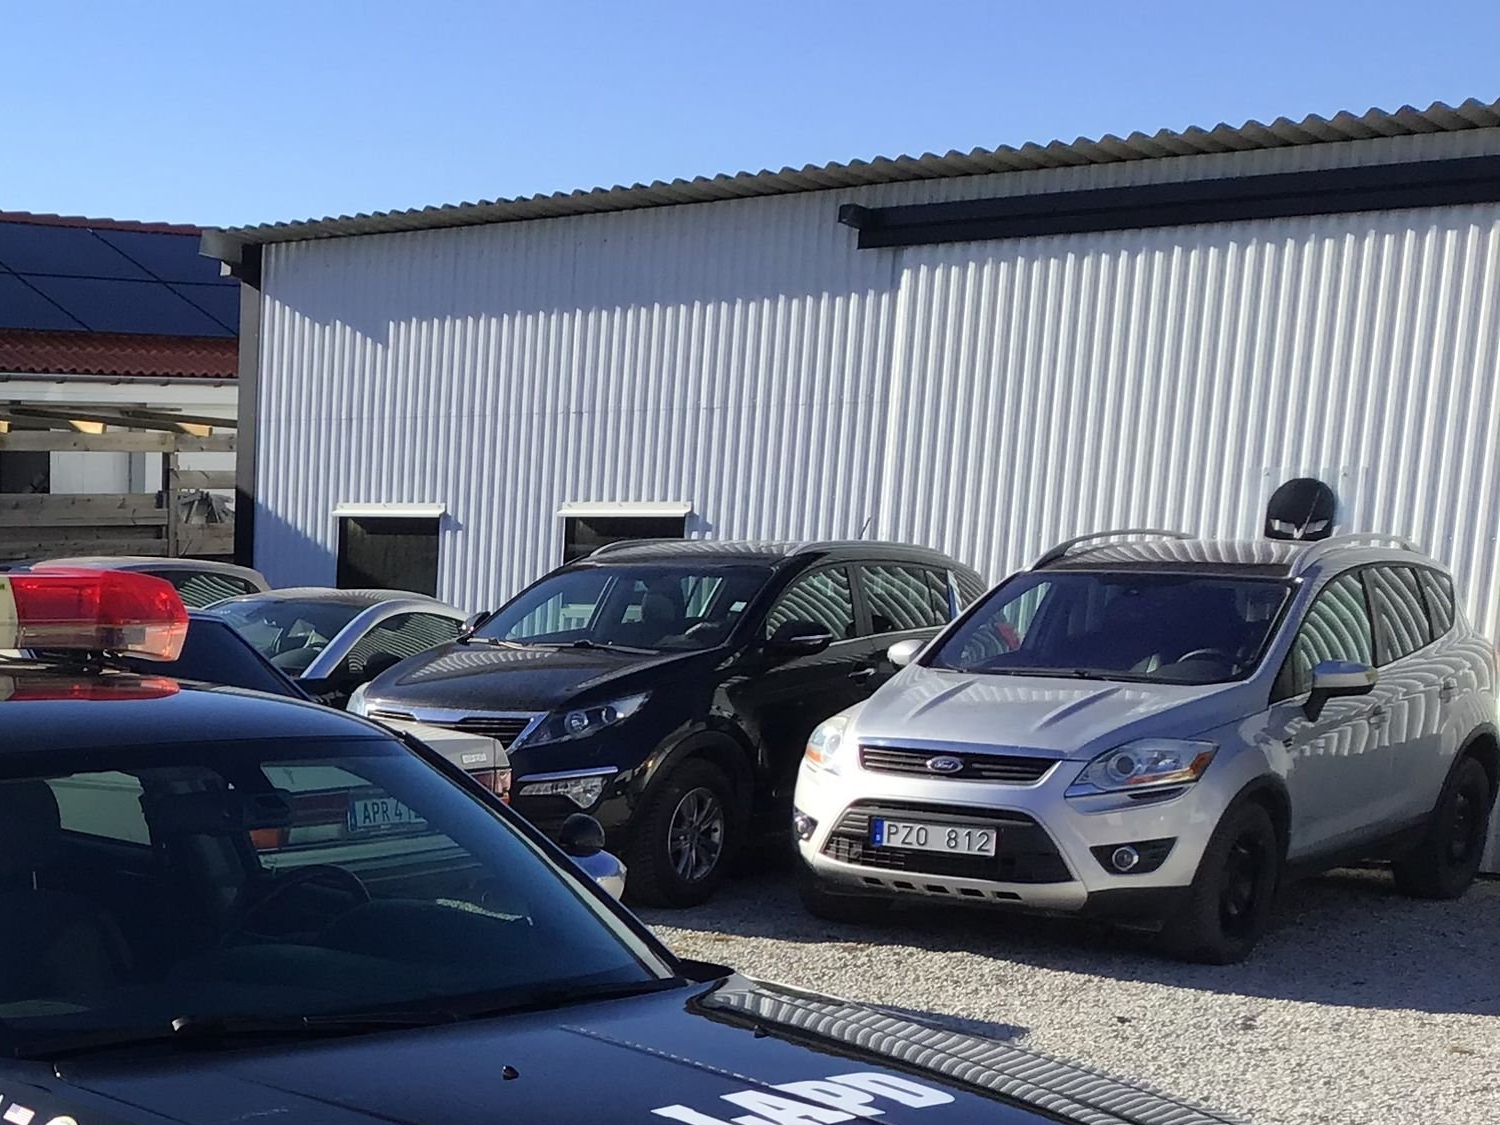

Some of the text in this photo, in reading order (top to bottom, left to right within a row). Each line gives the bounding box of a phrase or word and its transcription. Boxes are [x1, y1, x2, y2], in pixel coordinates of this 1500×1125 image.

[363, 801, 390, 824] APR
[887, 824, 990, 852] PZO 812
